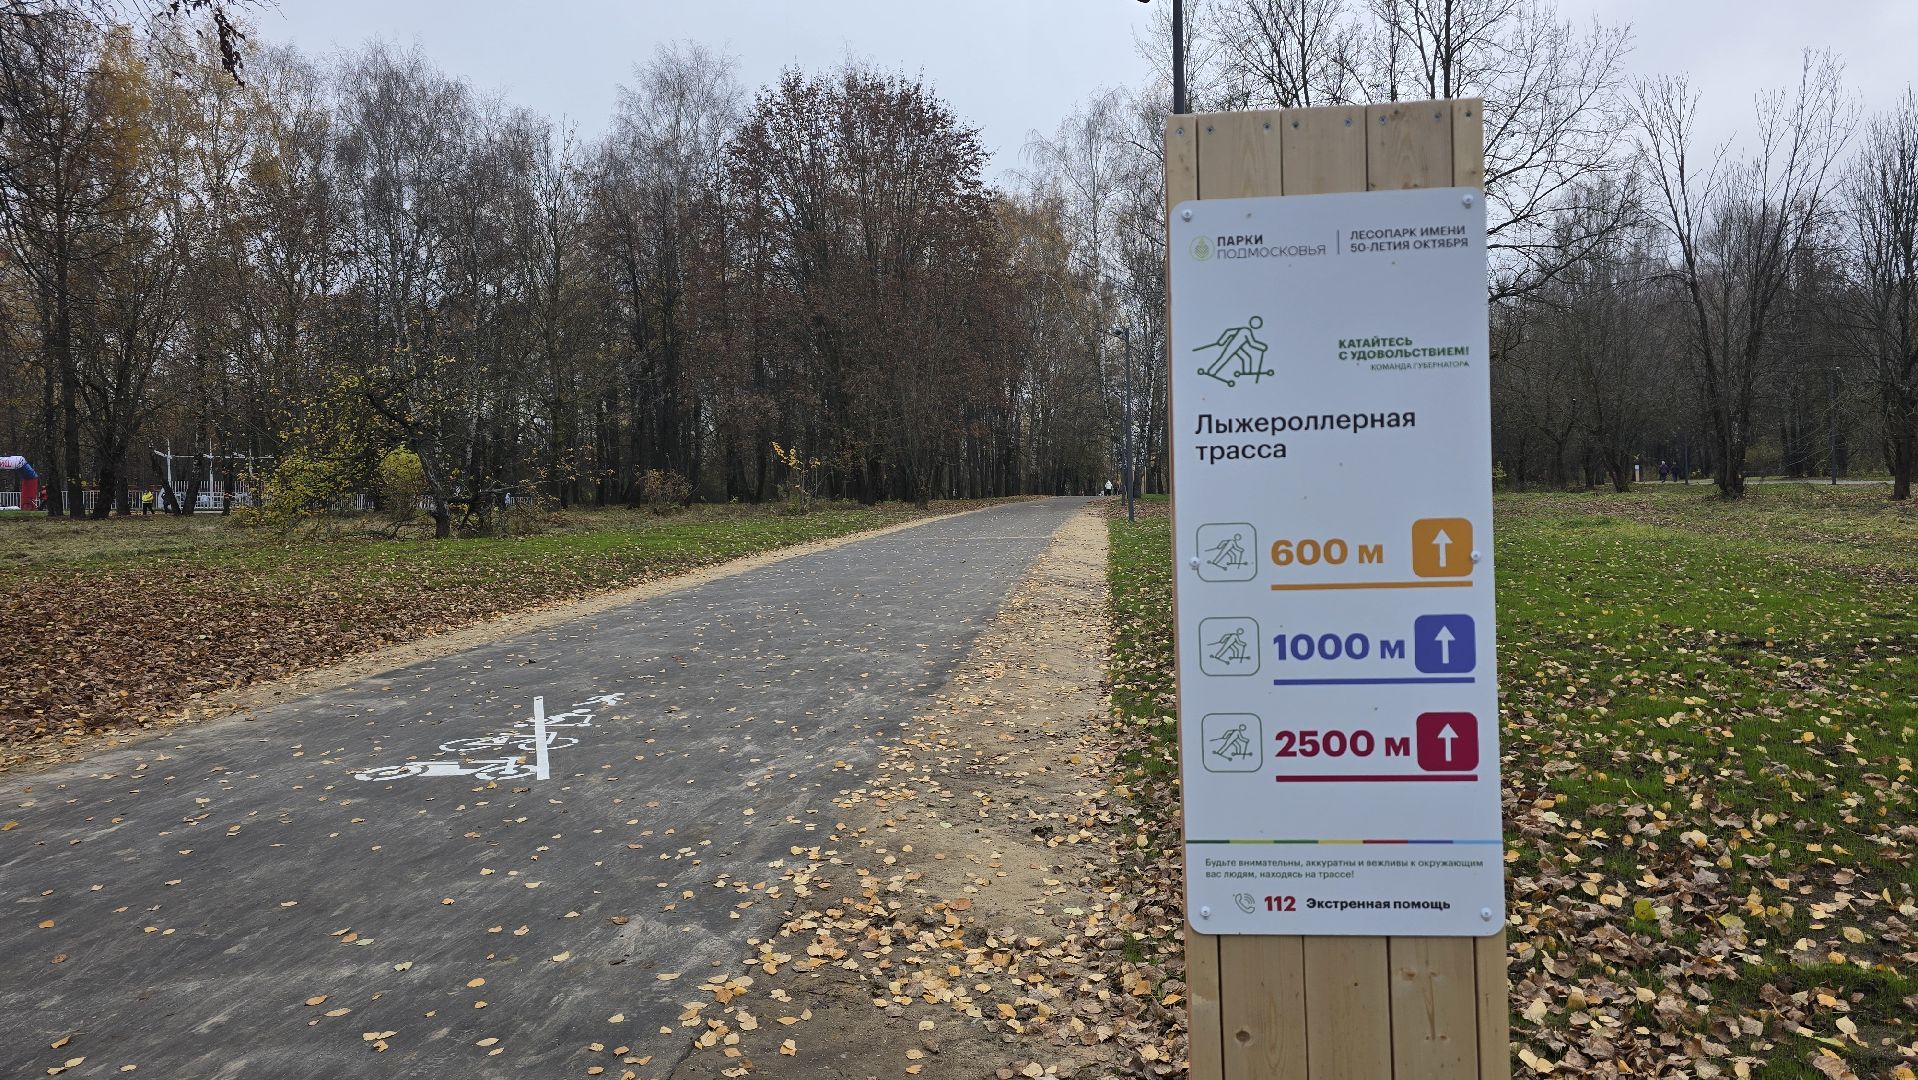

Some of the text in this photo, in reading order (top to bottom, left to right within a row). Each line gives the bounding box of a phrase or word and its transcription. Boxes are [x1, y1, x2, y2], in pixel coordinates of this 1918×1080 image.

[1217, 234, 1263, 246] ПАРКИ
[1350, 225, 1466, 240] ЛЕСОПАРК ИМЕНИ
[1217, 244, 1327, 259] ПОДМОСКОВЬЯ
[1350, 237, 1469, 253] 50-ЛЕТИЯ ОКТЯБРЯ
[1338, 335, 1413, 349] КАТАЙТЕСЬ
[1338, 346, 1470, 361] С УДОВОЛЬСТВИЕМ!
[1370, 360, 1470, 371] КОМАНДА ГУБЕРНАТОРА
[1195, 411, 1416, 436] Лыжероллерная
[1195, 443, 1287, 465] трасса
[1270, 538, 1348, 566] 600
[1273, 633, 1370, 661] 1000
[1275, 729, 1375, 758] 2500
[1205, 858, 1237, 868] Будьте
[1238, 859, 1303, 869] внимательны,
[1305, 859, 1356, 868] аккуратны
[1418, 860, 1484, 869] окружающим
[1205, 870, 1355, 880] вас людям, находясь на трассе!
[1264, 896, 1451, 911] 112 Экстренная помощь
